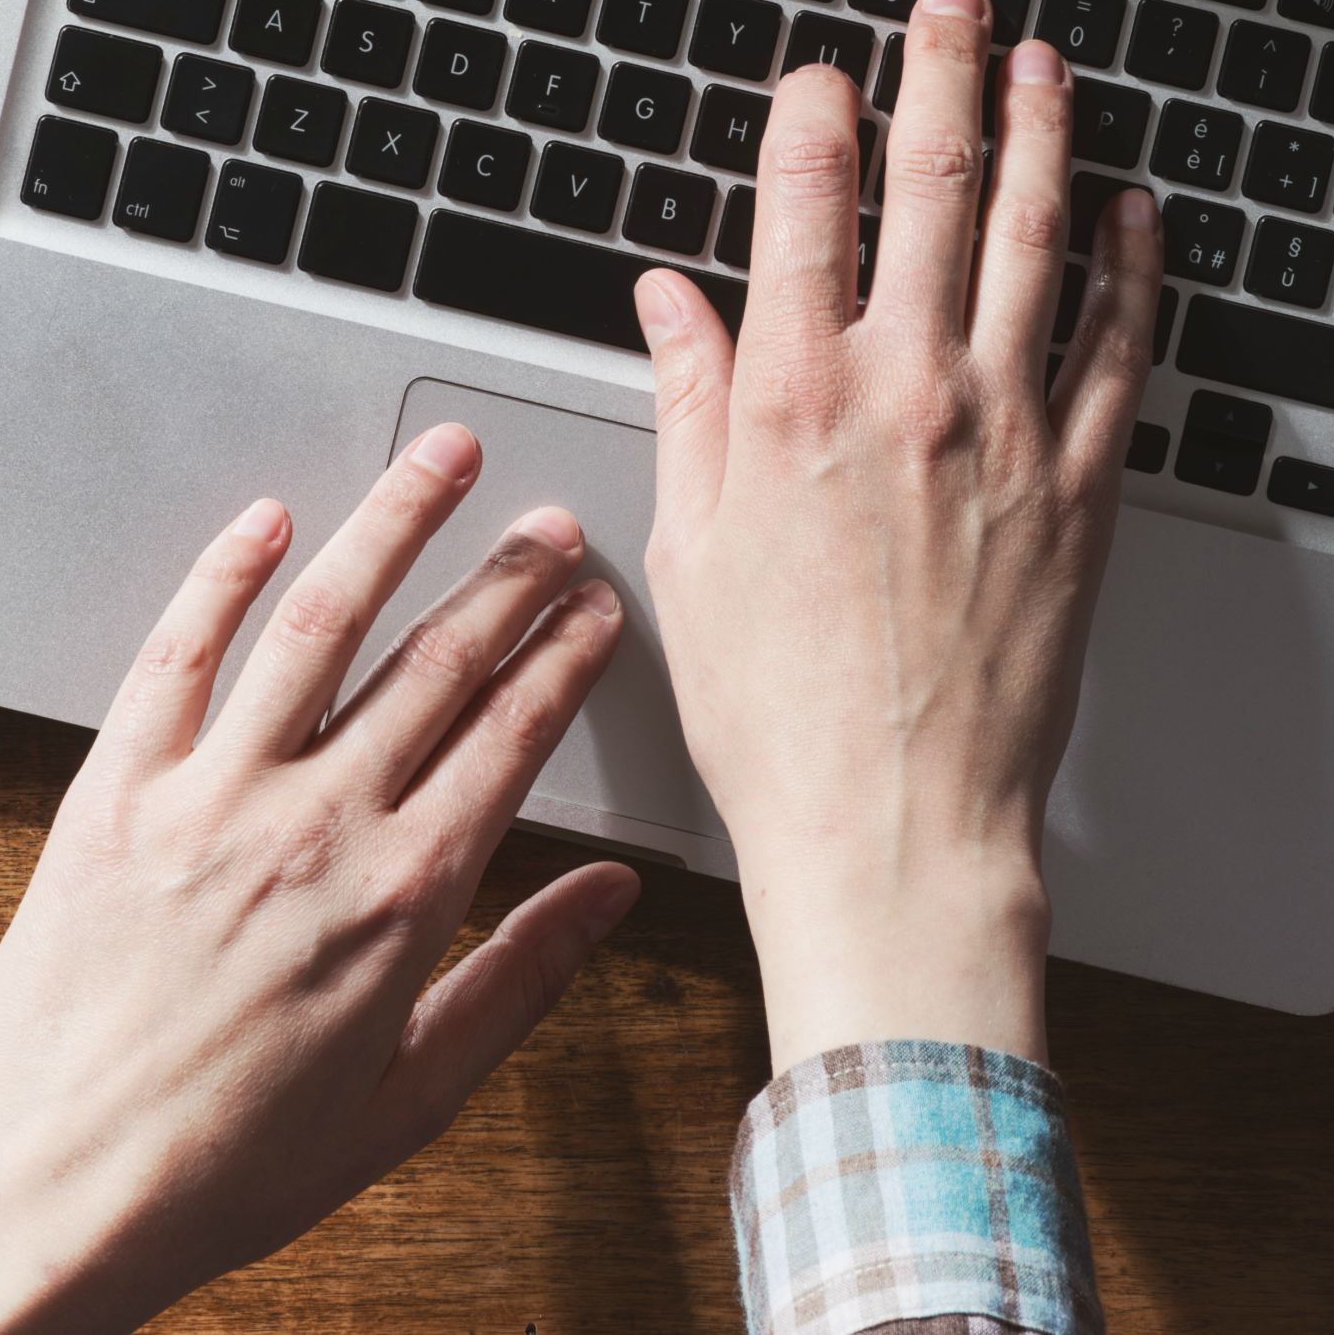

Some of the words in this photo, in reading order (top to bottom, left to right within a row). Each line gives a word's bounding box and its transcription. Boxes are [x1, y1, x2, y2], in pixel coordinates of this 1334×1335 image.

[264, 9, 283, 33] A
[639, 0, 652, 23] T
[730, 22, 745, 45] Y
[1172, 17, 1184, 37] ?
[358, 30, 375, 53] S
[450, 52, 469, 76] D
[819, 44, 839, 68] U
[202, 76, 217, 91] >
[546, 74, 562, 96] F
[195, 109, 211, 124] <
[635, 97, 655, 120] G
[290, 108, 309, 133] Z
[727, 117, 748, 142] H
[1097, 110, 1115, 134] P
[1194, 118, 1208, 139] é
[381, 130, 402, 155] X
[476, 154, 495, 177] C
[1186, 148, 1201, 170] è
[33, 178, 48, 195] fn
[229, 176, 246, 188] alt
[571, 174, 588, 198] V
[1279, 174, 1293, 188] +
[125, 203, 150, 219] ctrl
[661, 197, 677, 220] B
[1189, 243, 1203, 264] à
[1288, 237, 1302, 258] §
[1211, 249, 1226, 269] #
[1281, 267, 1295, 287] ù
